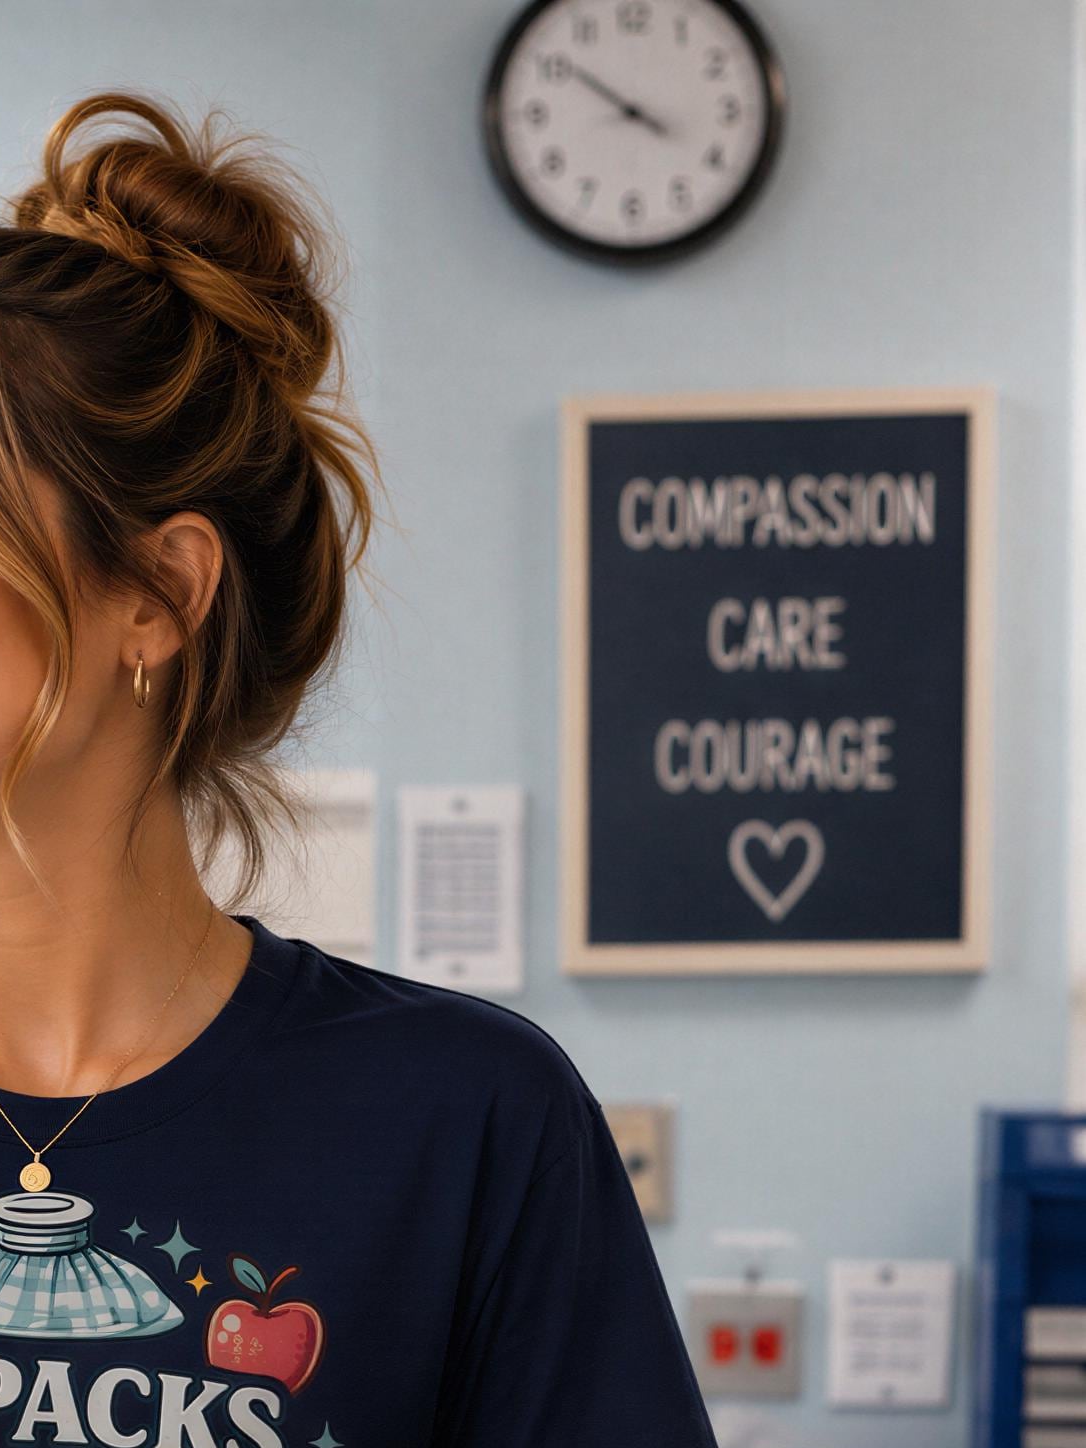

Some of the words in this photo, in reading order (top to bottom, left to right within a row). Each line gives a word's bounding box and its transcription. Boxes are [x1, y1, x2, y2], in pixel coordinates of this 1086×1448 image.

[619, 474, 935, 550] COMPASSION
[708, 598, 845, 671] CARE
[655, 718, 893, 792] COURAGE
